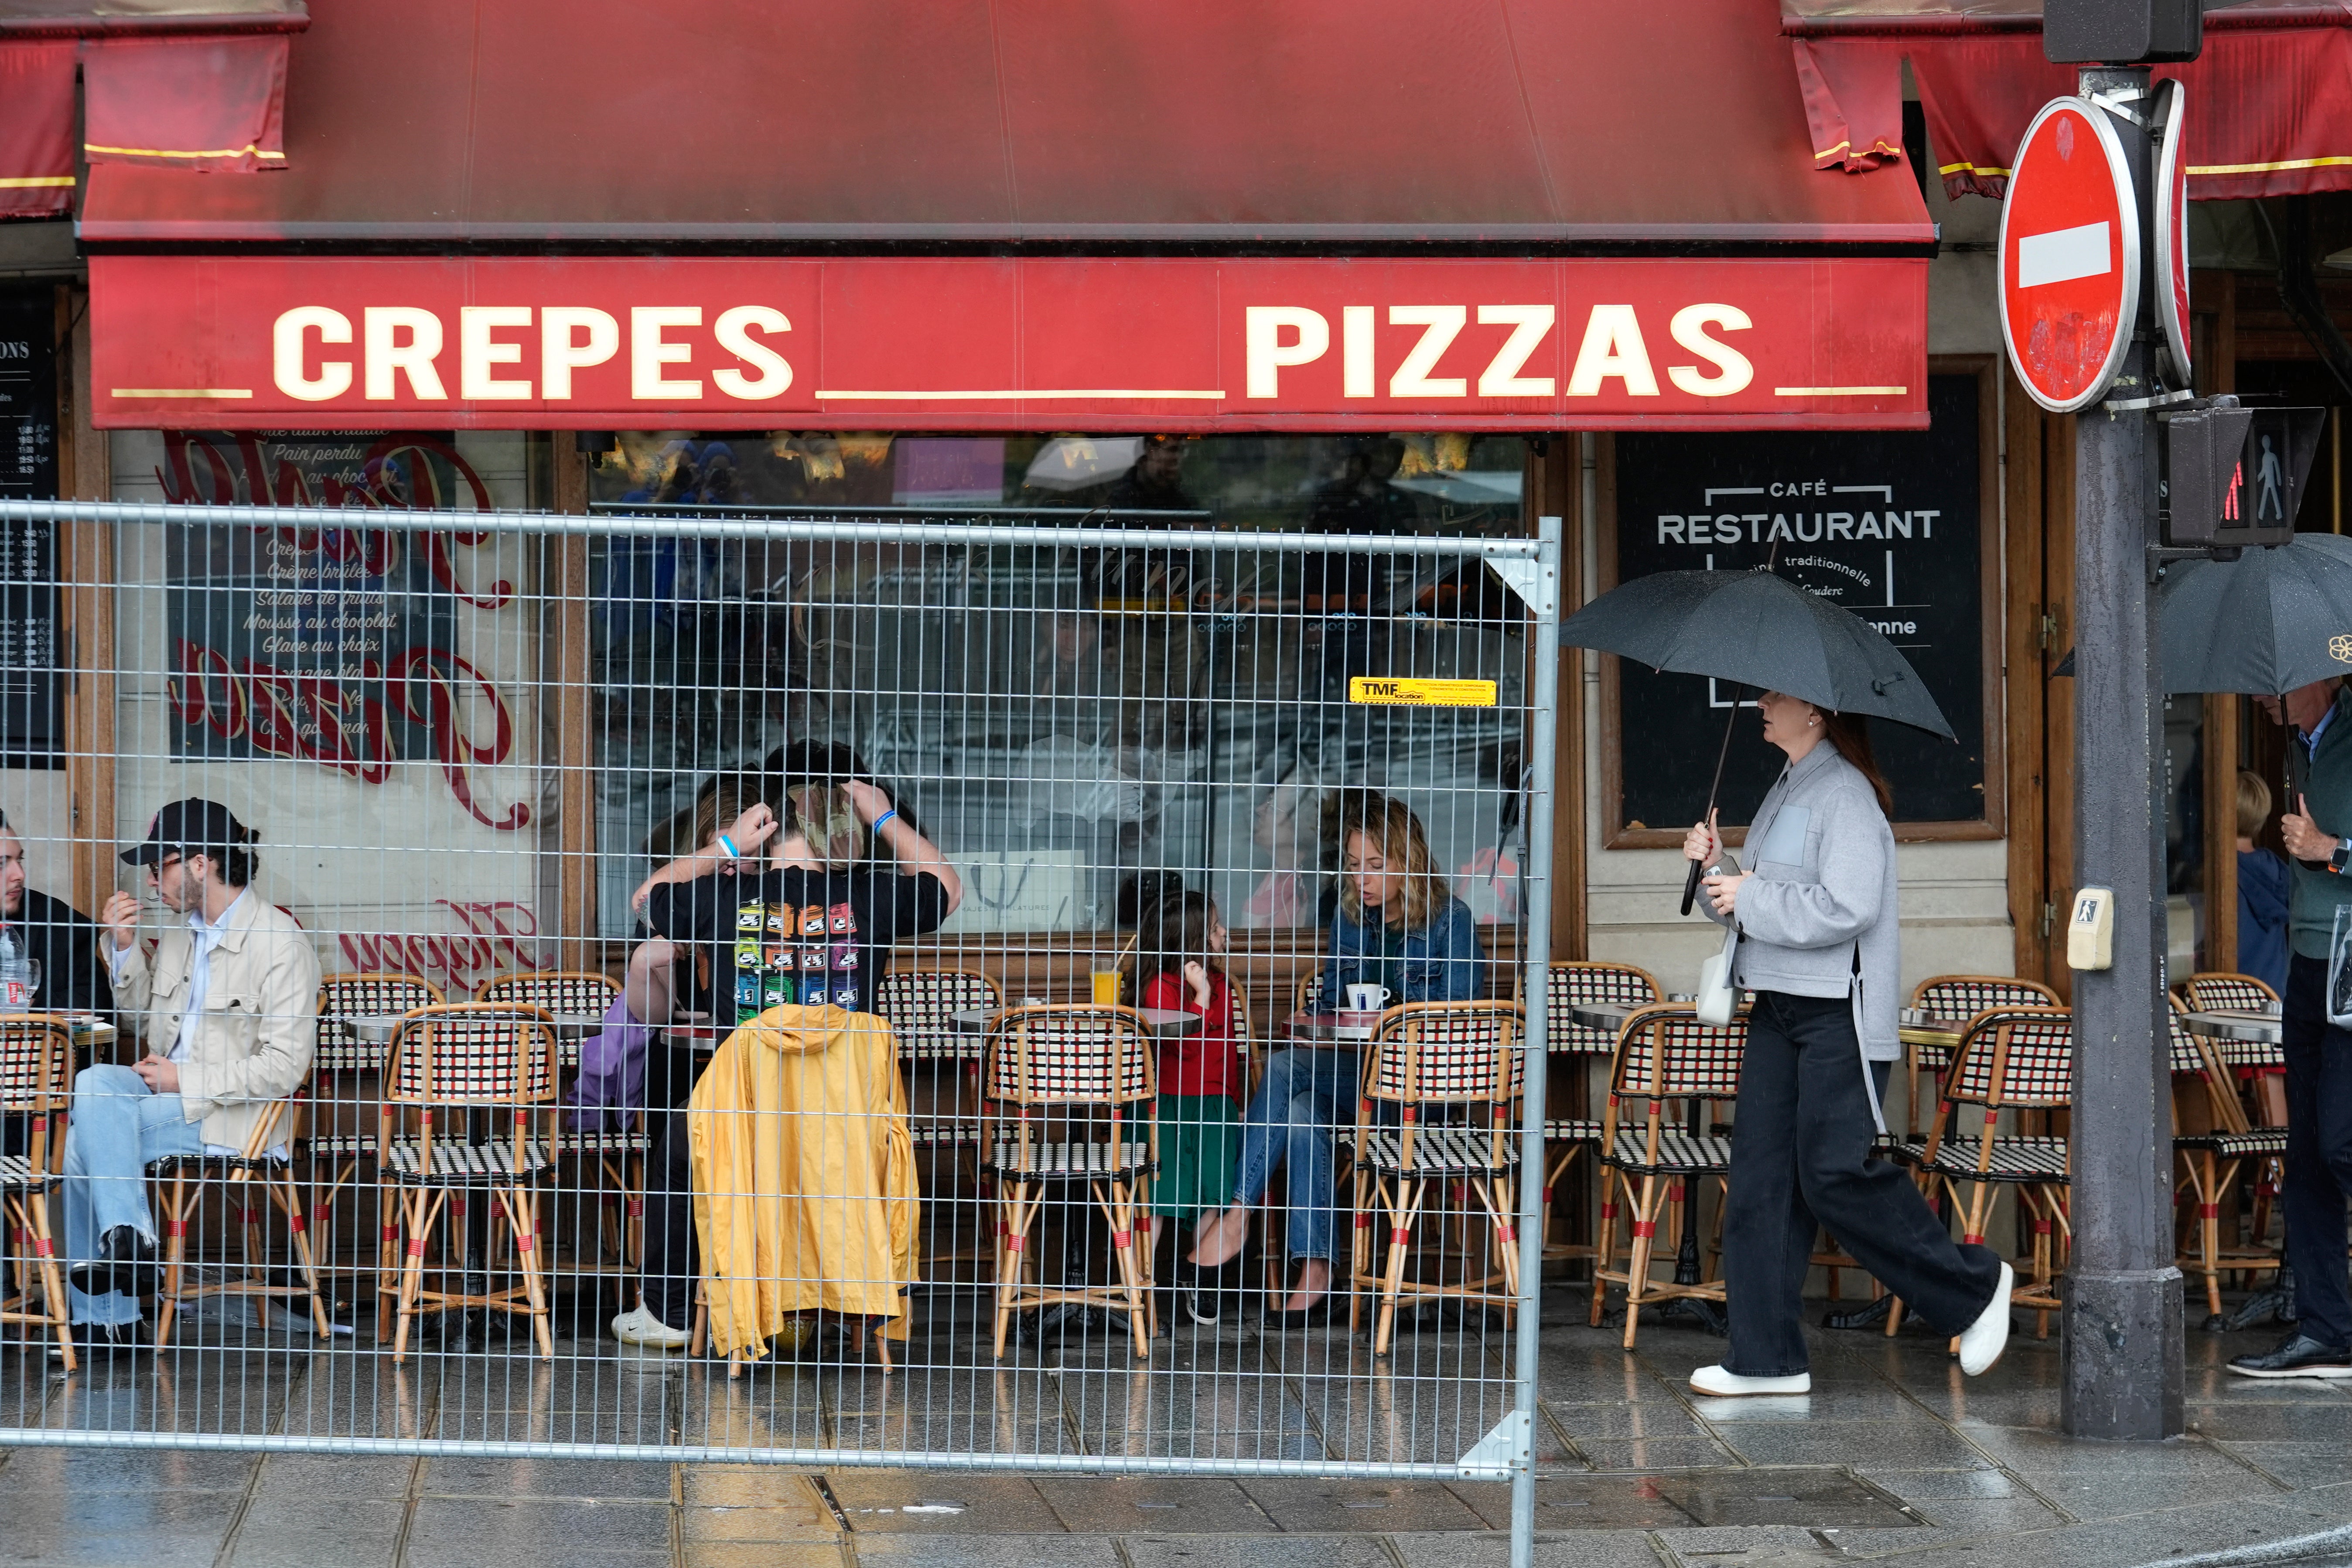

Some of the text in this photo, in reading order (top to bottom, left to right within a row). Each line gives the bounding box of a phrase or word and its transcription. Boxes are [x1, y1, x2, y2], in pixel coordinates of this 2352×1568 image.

[273, 306, 793, 401] CREPES
[1246, 303, 1753, 398] PIZZAS
[273, 444, 362, 465] Pain perdu
[1770, 479, 1827, 497] CAFÉ
[1658, 510, 1940, 544] RESTAURANT
[266, 562, 318, 579] Crème
[1785, 555, 1871, 588] traditionnelle
[255, 590, 313, 606] Salade
[317, 589, 336, 605] de
[243, 611, 398, 629] Mousse au chocolat
[263, 635, 380, 652] Glace au choix
[1362, 683, 1398, 696] TMF
